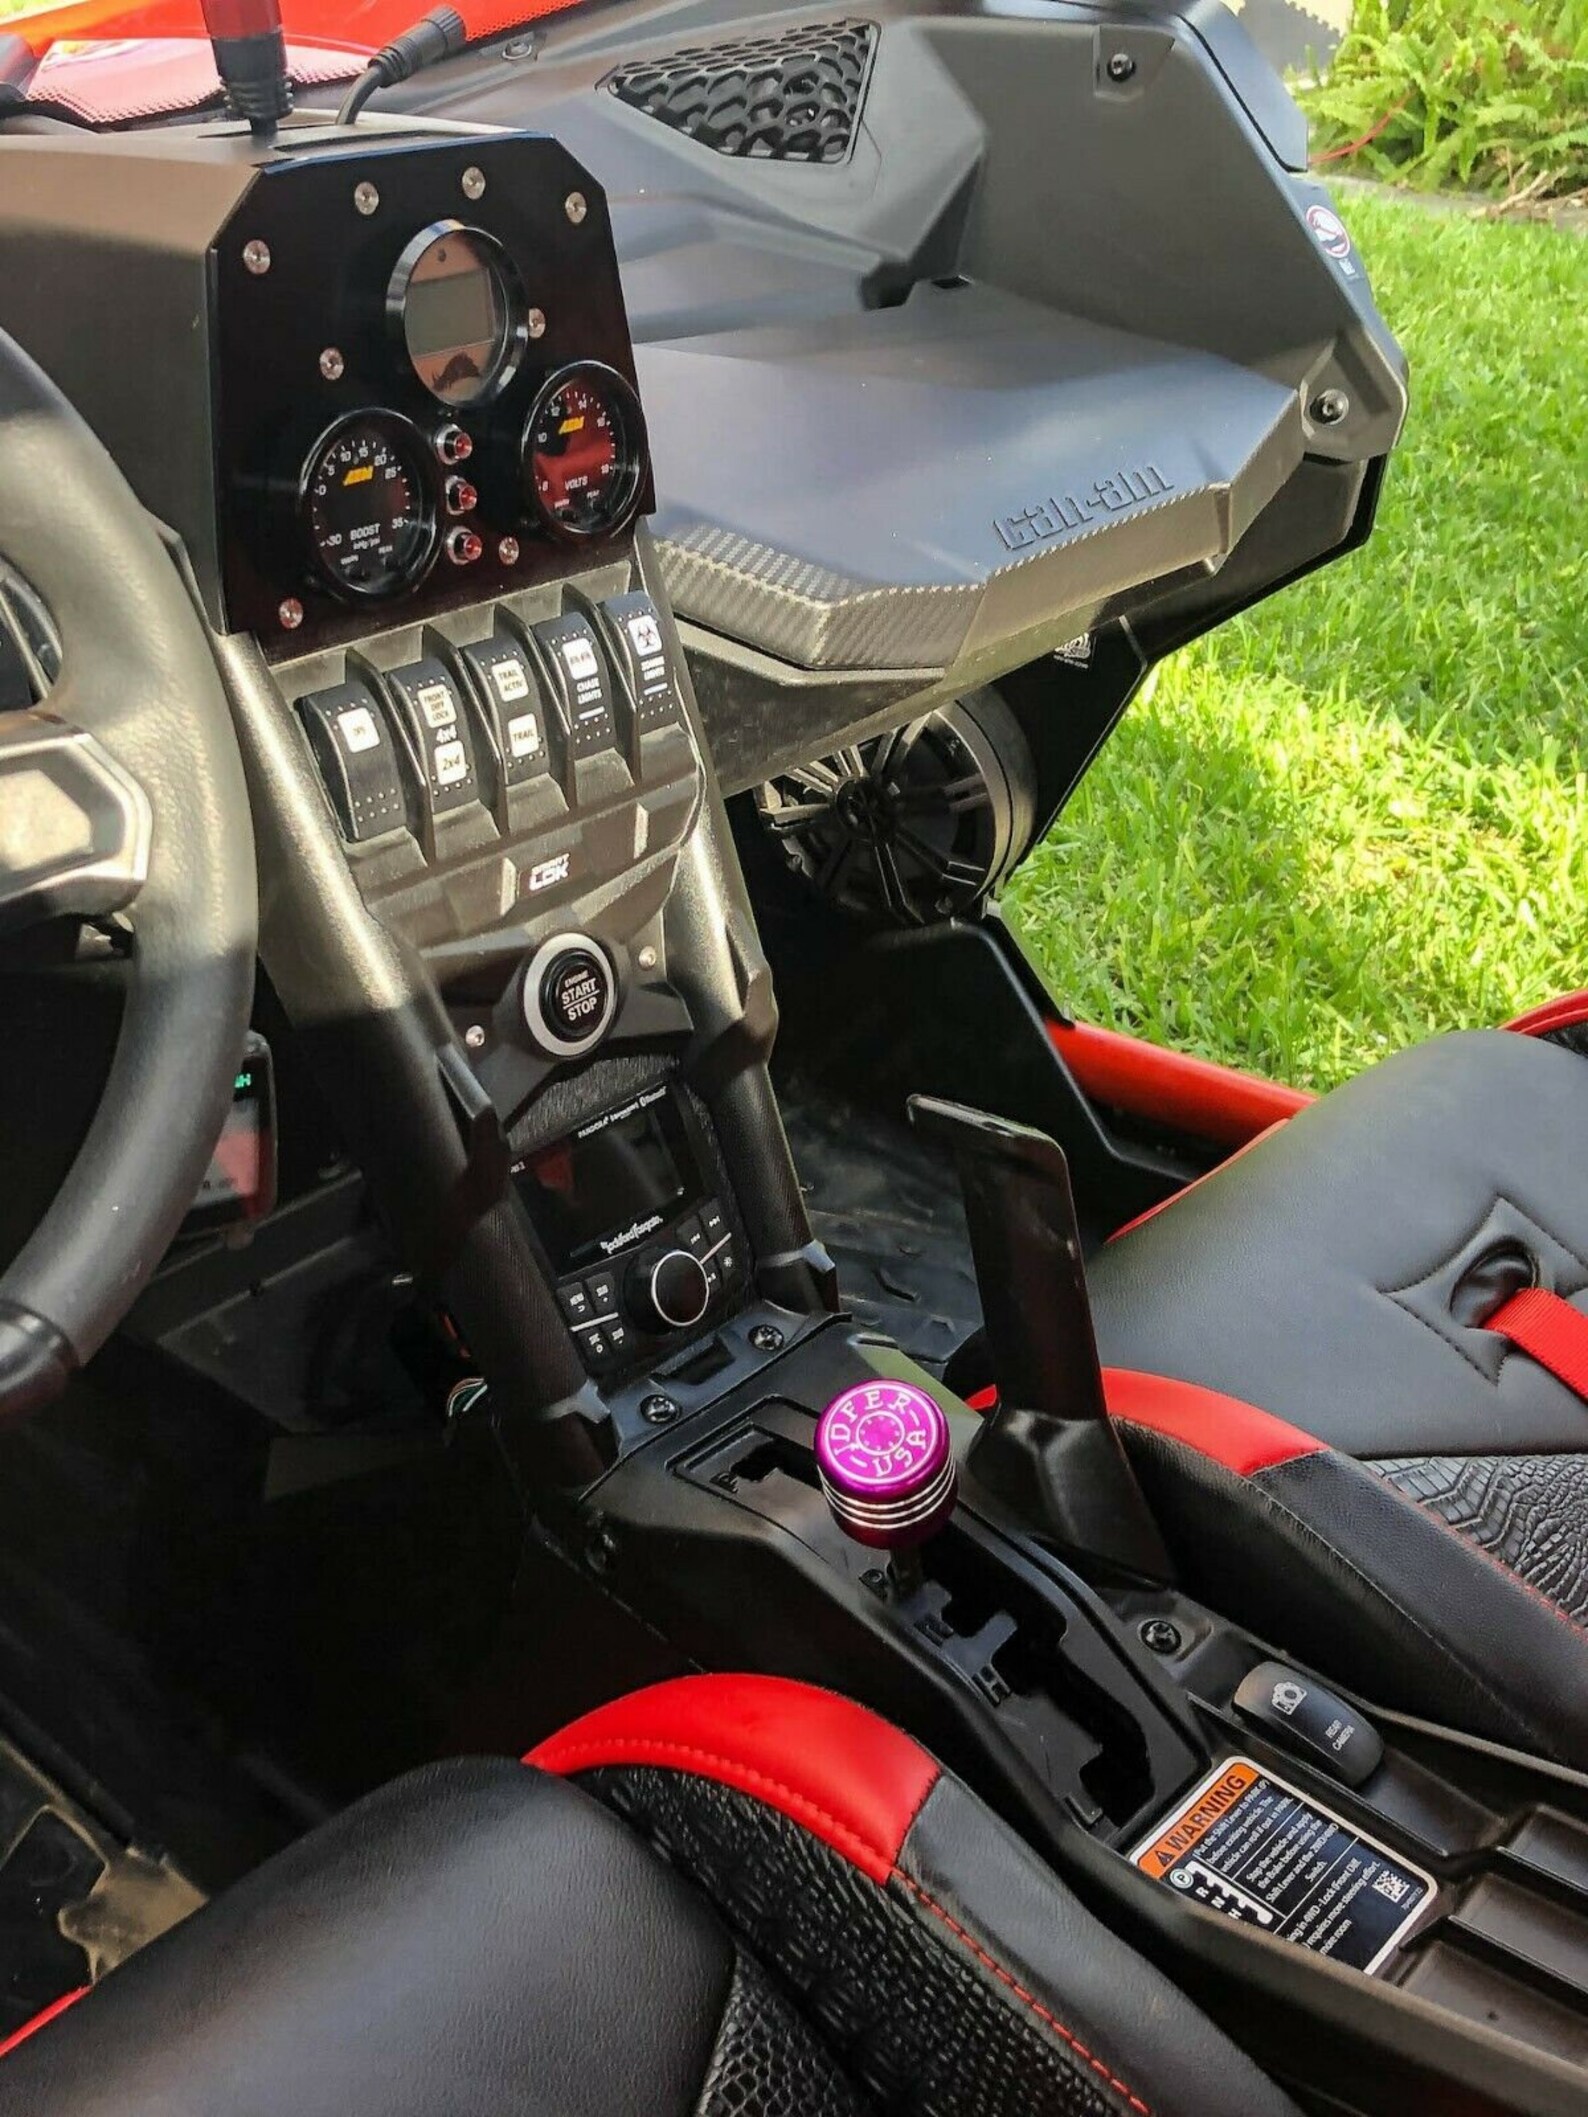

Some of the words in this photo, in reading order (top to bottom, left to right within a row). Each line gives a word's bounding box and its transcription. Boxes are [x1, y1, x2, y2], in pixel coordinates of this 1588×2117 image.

[538, 432, 547, 443] 10
[340, 451, 351, 462] 10
[359, 447, 369, 457] 15
[374, 453, 387, 466] 20
[385, 467, 397, 479] 25
[565, 475, 588, 491] VOLTS
[350, 523, 380, 541] BOOST
[392, 517, 403, 529] 35
[513, 729, 535, 741] TRAIL
[564, 969, 589, 988] ENGINE
[561, 978, 597, 1005] START
[567, 997, 598, 1022] STOP
[872, 1429, 926, 1477] USA
[1325, 1719, 1342, 1738] REAR
[1332, 1724, 1355, 1750] CAMERA
[1166, 1774, 1246, 1852] WARNING
[1204, 1835, 1218, 1847] the
[1212, 1821, 1230, 1837] Shift
[1224, 1807, 1243, 1825] Lever
[1206, 1844, 1229, 1865] before
[1225, 1826, 1247, 1847] exiting
[1259, 1796, 1274, 1808] The
[1220, 1851, 1242, 1873] vehicle
[1239, 1841, 1253, 1854] can
[1248, 1830, 1260, 1844] roll
[1246, 1866, 1263, 1882] Stop
[1258, 1856, 1272, 1869] the
[1268, 1837, 1289, 1859] vehicle
[1286, 1825, 1299, 1841] and
[1296, 1812, 1314, 1830] apply
[1257, 1876, 1271, 1890] the
[1265, 1861, 1286, 1880] Brake
[1279, 1843, 1301, 1864] before
[1297, 1828, 1316, 1846] using
[1309, 1819, 1322, 1831] the
[1265, 1886, 1283, 1903] Shift
[1277, 1871, 1296, 1890] Lever
[1293, 1858, 1307, 1875] and
[1301, 1850, 1315, 1863] the
[1195, 1886, 1209, 1898] R
[1211, 1896, 1225, 1909] N
[1228, 1907, 1242, 1920] H
[1303, 1904, 1321, 1923] 4WD
[1318, 1887, 1337, 1905] Lock
[1306, 1918, 1332, 1946] requires
[1327, 1901, 1346, 1921] more
[1341, 1878, 1368, 1905] steering
[1319, 1936, 1338, 1956] more
[1334, 1919, 1352, 1939] room
